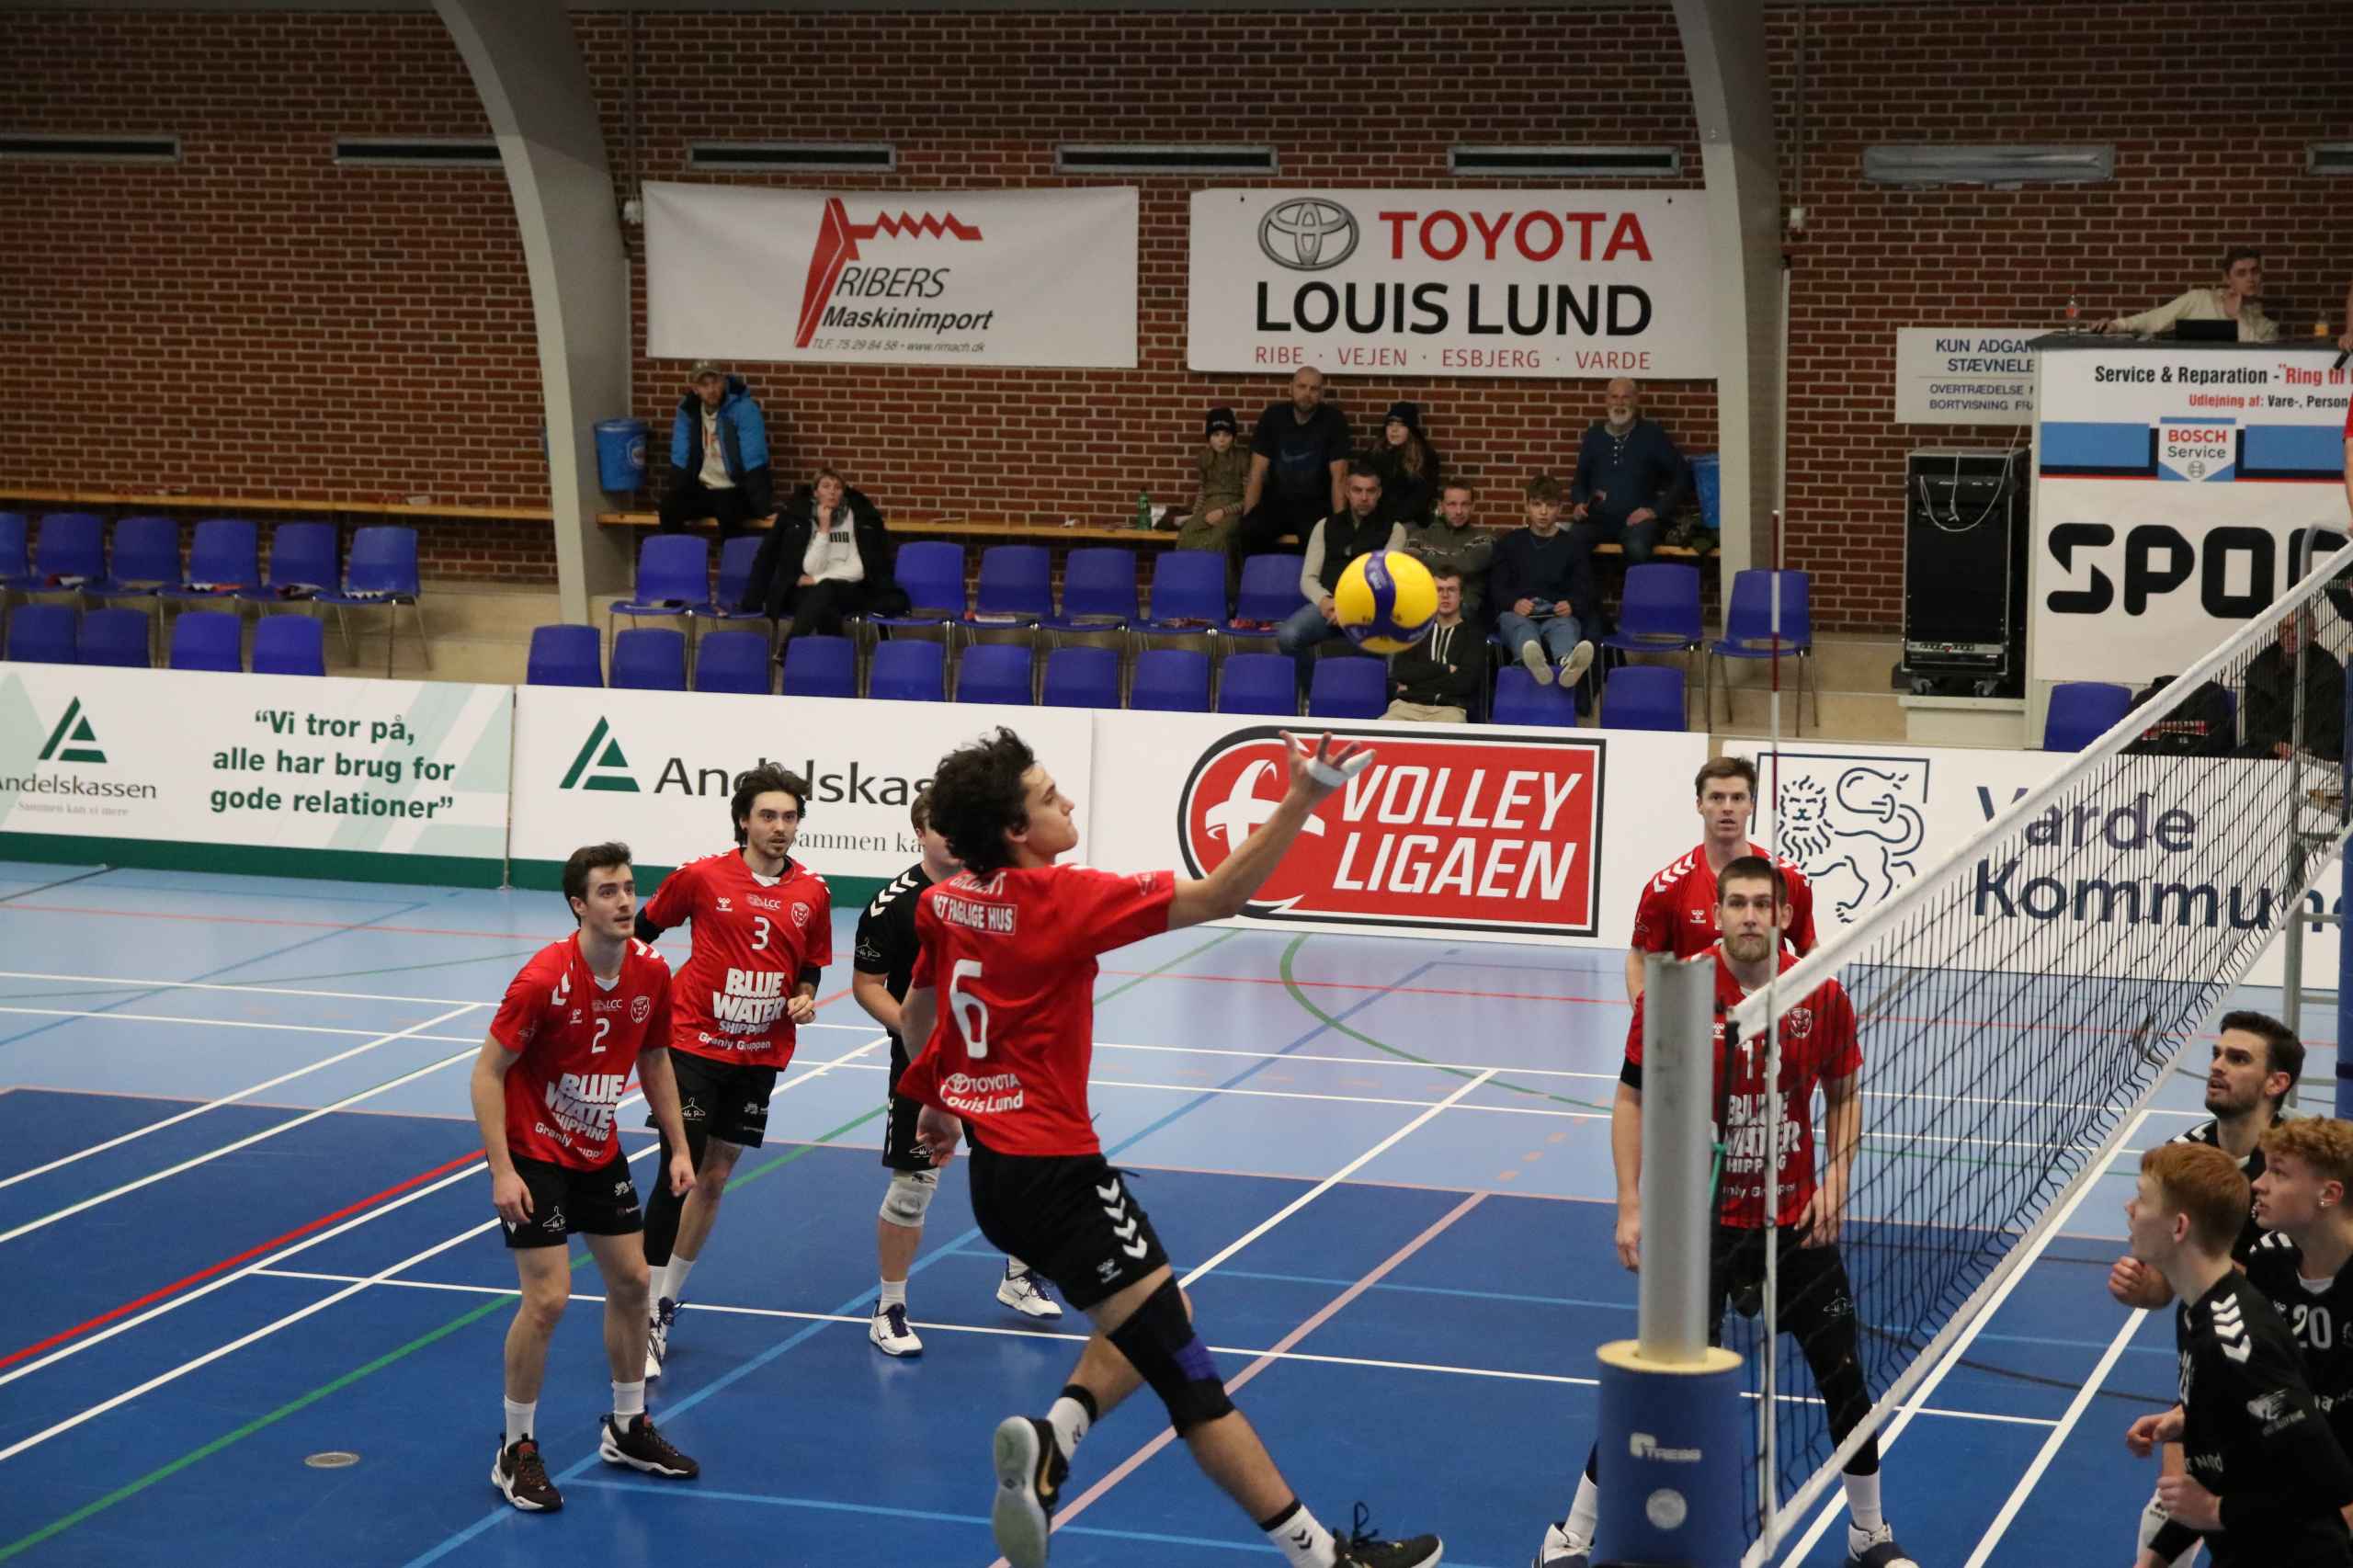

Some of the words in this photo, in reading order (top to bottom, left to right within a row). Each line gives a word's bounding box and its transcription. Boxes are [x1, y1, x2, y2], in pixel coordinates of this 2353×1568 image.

[1379, 210, 1653, 262] TOYOTA
[835, 266, 950, 299] RIBERS
[823, 305, 993, 335] Maskinimport
[1256, 280, 1449, 335] LOUIS
[1468, 283, 1653, 336] LUND
[1255, 346, 1305, 365] RIBE
[1337, 347, 1408, 368] VEJEN
[1441, 348, 1541, 369] ESBJERG
[1575, 350, 1652, 370] VARDE
[1935, 338, 1971, 353] KUN
[1929, 383, 2024, 395] OVERTRÆDELSE
[2095, 365, 2155, 383] Service
[2161, 367, 2173, 383] &
[2177, 366, 2268, 386] Reparation
[1929, 399, 2008, 411] BORTVISNING
[2188, 393, 2245, 409] Udlejning
[2167, 428, 2228, 443] BOSCH
[2166, 445, 2227, 459] Service
[305, 712, 361, 738] tror
[369, 713, 416, 746] på,
[212, 747, 266, 772] alle
[275, 749, 324, 775] har
[334, 751, 402, 784] brug
[413, 756, 456, 782] for
[210, 786, 282, 813] gode
[1342, 765, 1583, 831] VOLLEY
[895, 832, 923, 853] ka
[1333, 831, 1577, 901] LIGAEN
[764, 898, 781, 909] LCC
[1974, 857, 2343, 933] Kommun
[751, 915, 770, 951] 3
[987, 906, 1014, 931] HUS
[724, 967, 786, 997] BLUE
[606, 999, 623, 1009] LCC
[712, 991, 787, 1024] WATER
[949, 958, 989, 1059] 6
[591, 1017, 610, 1054] 2
[559, 1074, 625, 1104] BLUE
[971, 1073, 1022, 1093] TOYOTA
[535, 1121, 573, 1147] Granly
[2291, 1304, 2333, 1350] 20
